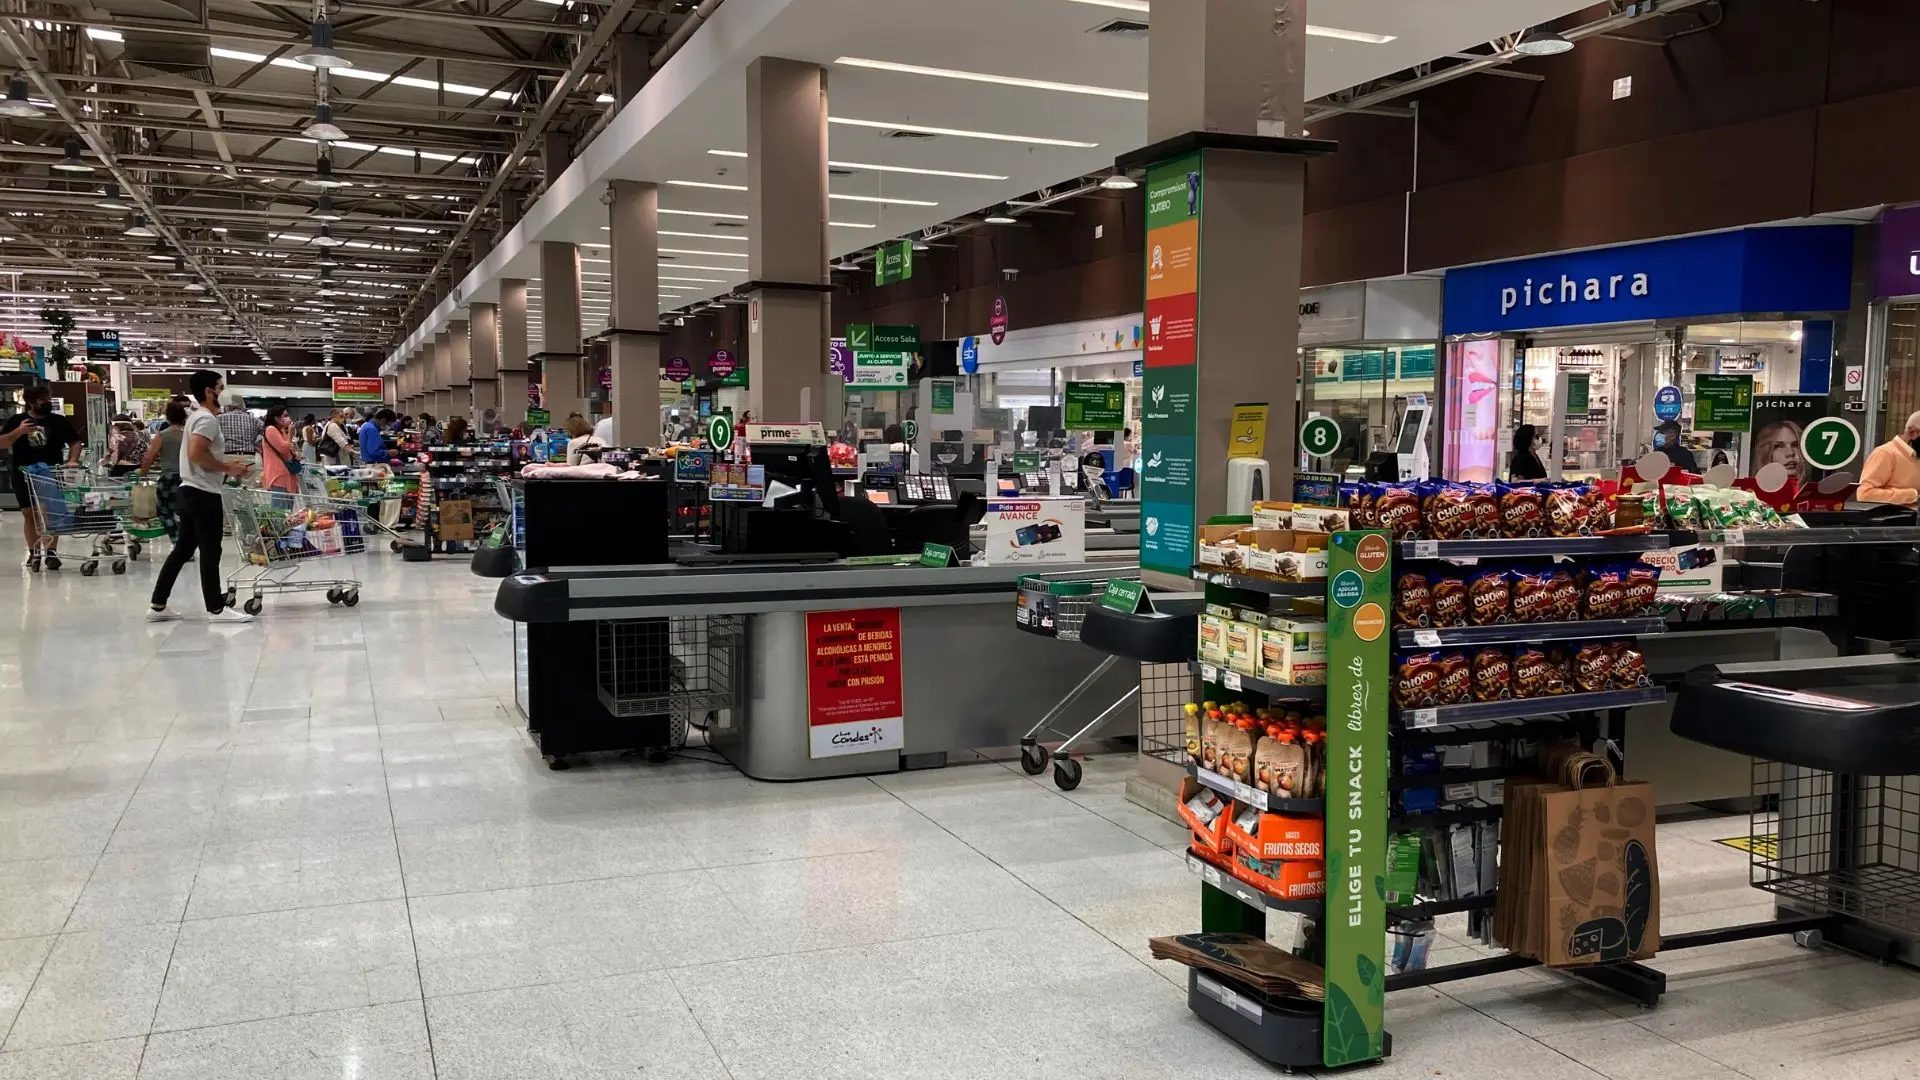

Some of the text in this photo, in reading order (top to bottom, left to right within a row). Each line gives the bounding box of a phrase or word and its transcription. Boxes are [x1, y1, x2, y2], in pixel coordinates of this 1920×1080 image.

[886, 254, 900, 266] Acceso
[1502, 273, 1648, 315] pichara
[102, 332, 117, 340] 16b
[874, 335, 898, 343] Acceso
[1756, 400, 1812, 408] pichara
[717, 428, 724, 440] 9
[761, 429, 791, 439] prime
[1314, 427, 1326, 446] 8
[1822, 432, 1839, 455] 7
[1000, 512, 1038, 520] AVANCE
[1380, 504, 1412, 525] CHOCO
[1437, 503, 1472, 521] CHOCO
[1505, 503, 1534, 520] CHOCO
[1108, 583, 1136, 600] Caja cerrada
[1552, 586, 1576, 602] HOCO
[1590, 590, 1621, 605] CHOCO
[1626, 586, 1652, 598] HOCO
[1436, 594, 1464, 610] CHOC
[1514, 591, 1547, 608] CHOCO
[824, 624, 832, 632] LA
[858, 631, 893, 640] DE BEBIDAS
[817, 646, 857, 656] ALCOHÓLICAS
[864, 642, 892, 652] MENORES
[854, 653, 893, 664] ESTÁ PENADA
[1440, 668, 1469, 688] CHOCO
[1477, 662, 1508, 680] CHOCO
[848, 676, 884, 687] CON PRISIÓN
[1400, 672, 1433, 689] CHOCO
[832, 731, 869, 744] Condes
[1347, 656, 1364, 926] ELIGE TU SNACK libres de
[1264, 842, 1320, 855] FRUTOS SECOS
[1289, 883, 1316, 896] FRUTOS
